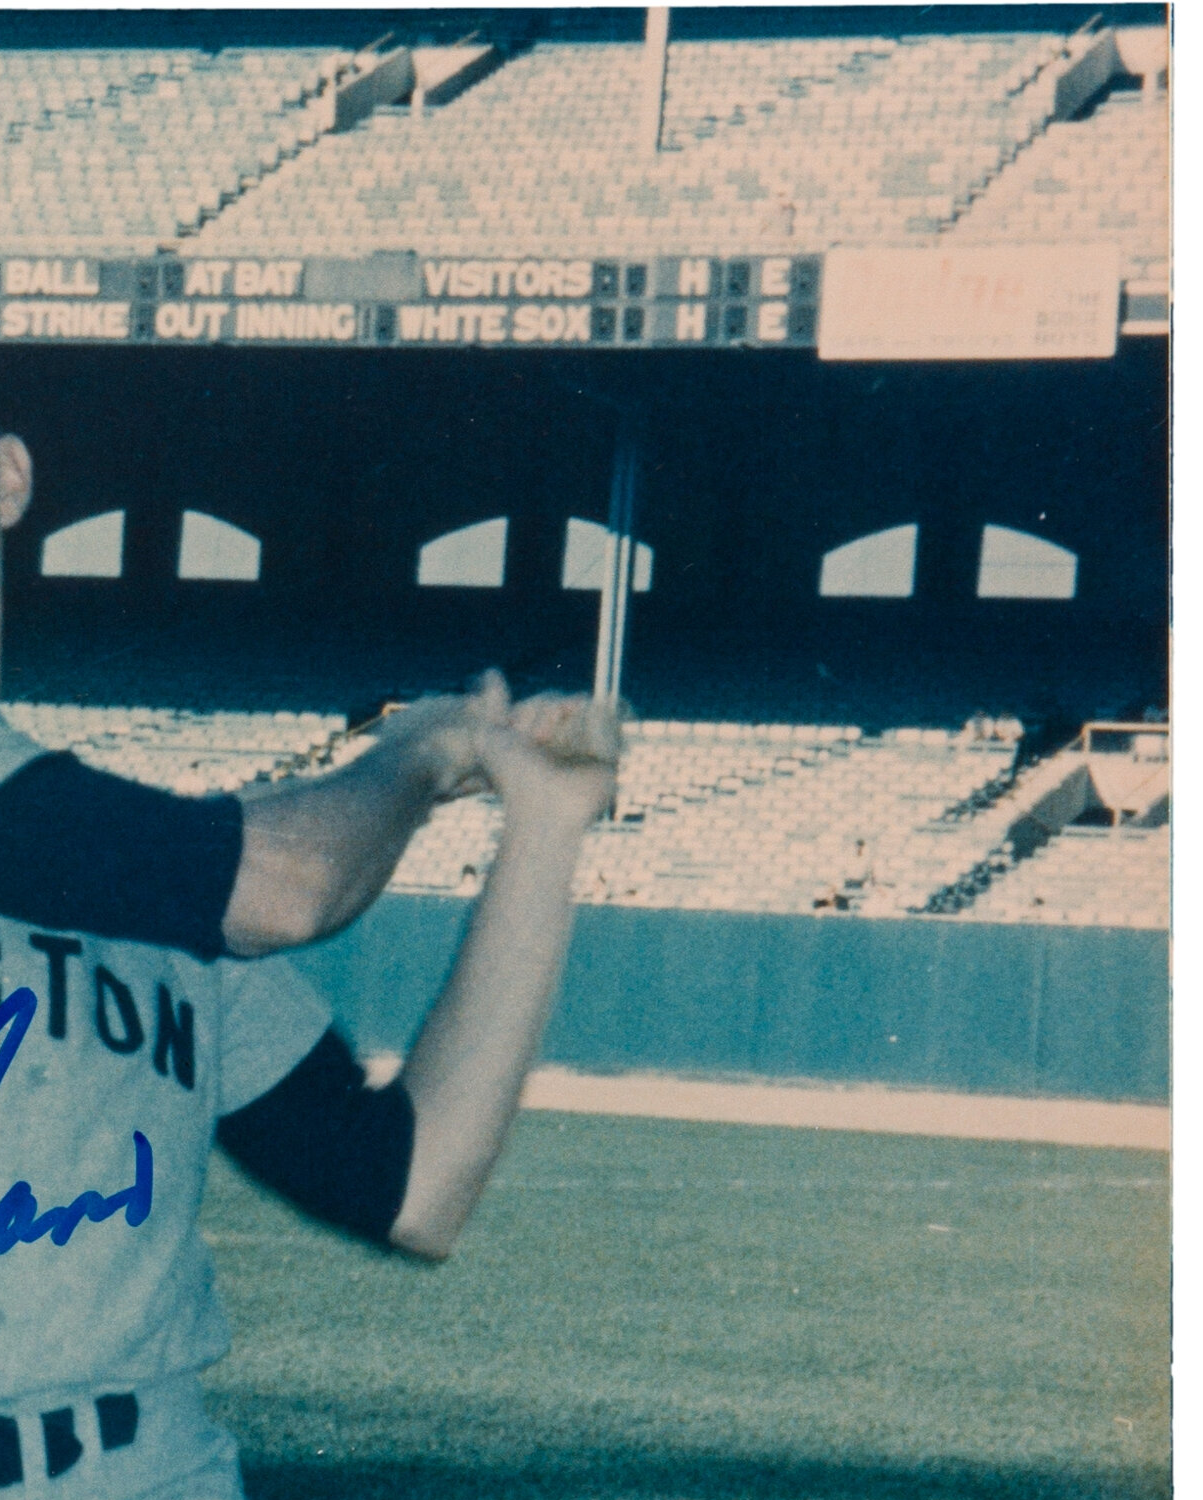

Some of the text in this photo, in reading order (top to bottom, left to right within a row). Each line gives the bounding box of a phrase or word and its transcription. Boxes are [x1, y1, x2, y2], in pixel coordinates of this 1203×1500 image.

[5, 259, 99, 296] BALL
[184, 260, 303, 297] AT BAT
[424, 259, 595, 298] VISITORS
[678, 257, 791, 296] H E
[0, 302, 130, 339] STRIKE
[155, 303, 356, 340] OUT INNING
[399, 304, 591, 341] WHITE SOX
[675, 302, 788, 341] H E
